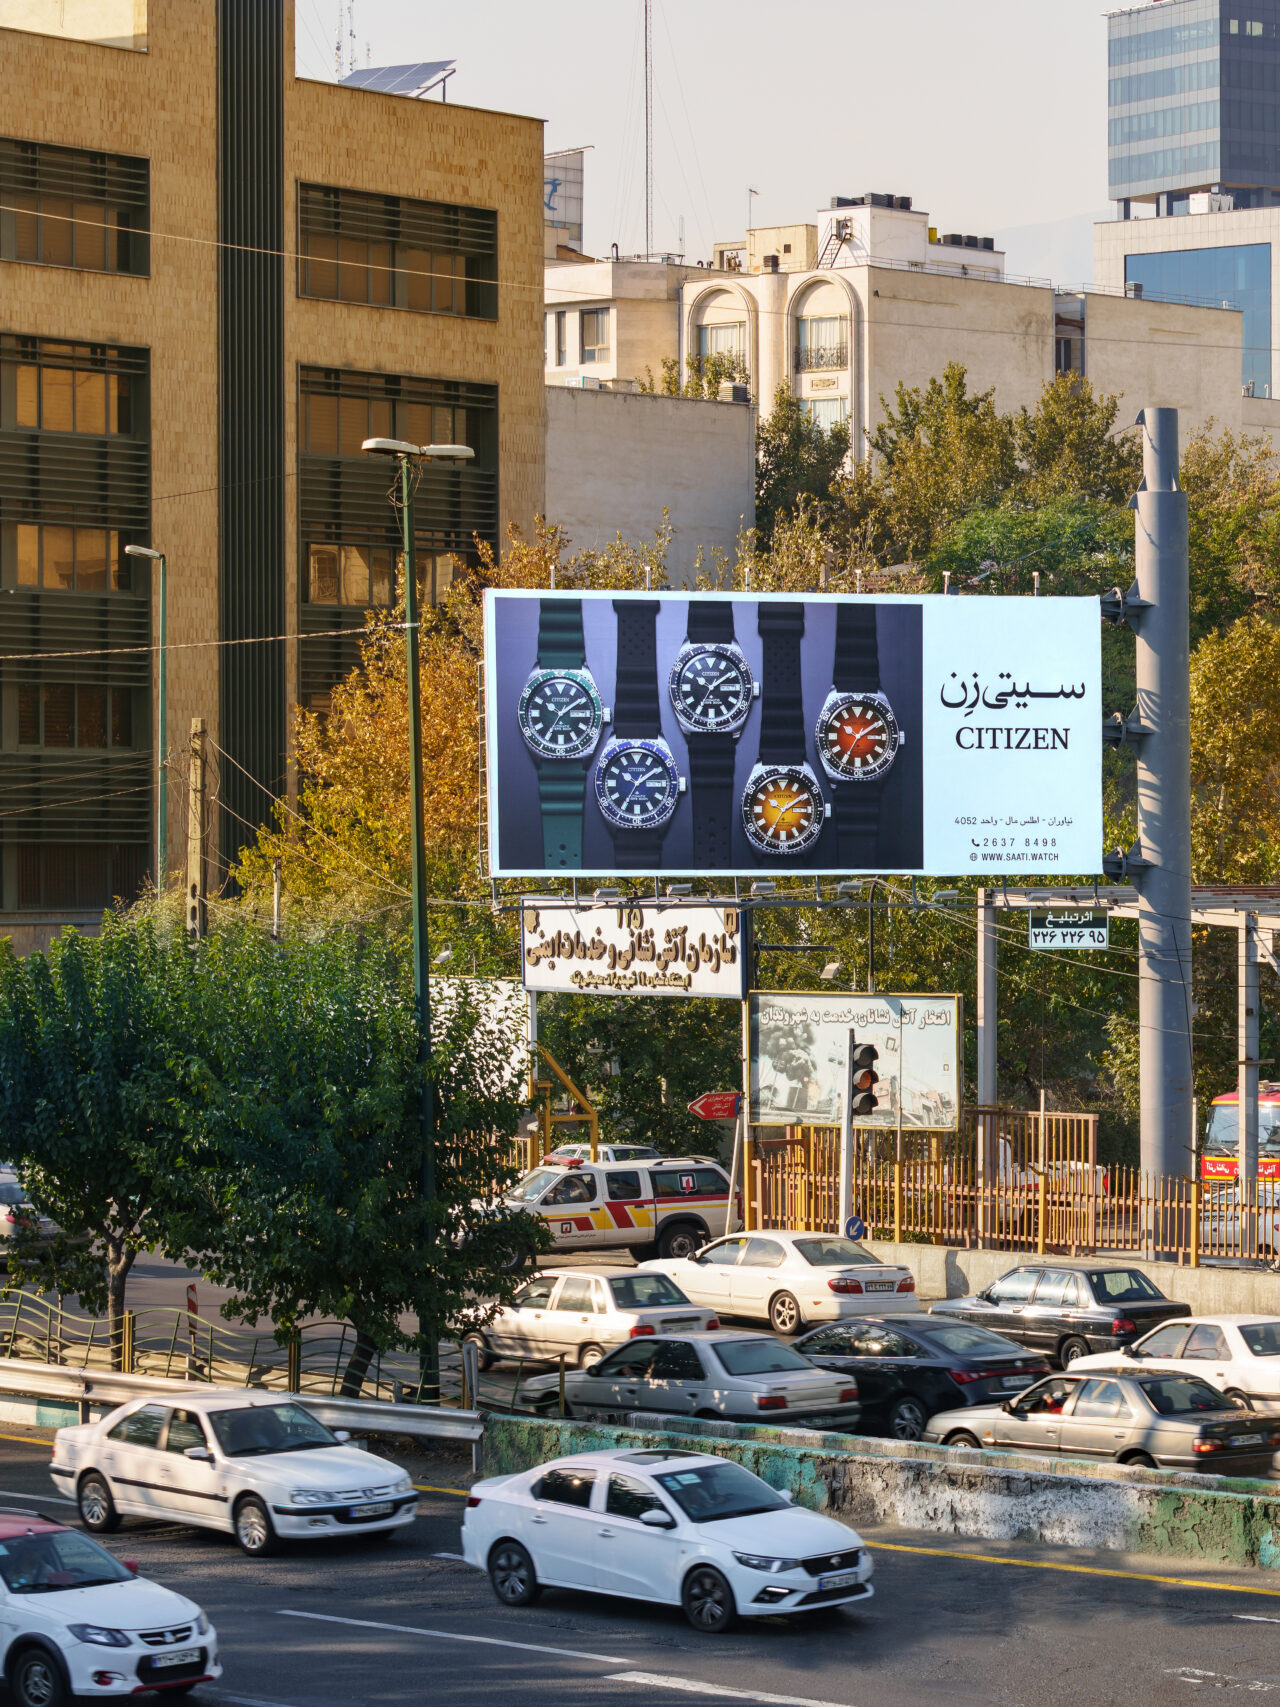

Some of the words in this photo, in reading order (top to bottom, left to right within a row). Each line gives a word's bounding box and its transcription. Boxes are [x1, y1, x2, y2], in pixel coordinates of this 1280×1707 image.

[955, 726, 1070, 750] CITIZEN
[954, 816, 977, 825] 4052
[980, 816, 998, 826] واحد
[1020, 816, 1039, 826] اطلس
[1048, 816, 1073, 826] نیاوران
[981, 852, 1059, 861] WWW.SAATI.WATCH
[526, 929, 561, 970] ایمنی
[561, 926, 607, 960] خدمات
[617, 928, 656, 970] نشانی
[656, 925, 688, 971] آتش
[686, 932, 736, 973] سازمان
[608, 943, 617, 970] و
[760, 1006, 808, 1026] شهروندان
[809, 1009, 821, 1025] به
[918, 1010, 951, 1029] افتخار
